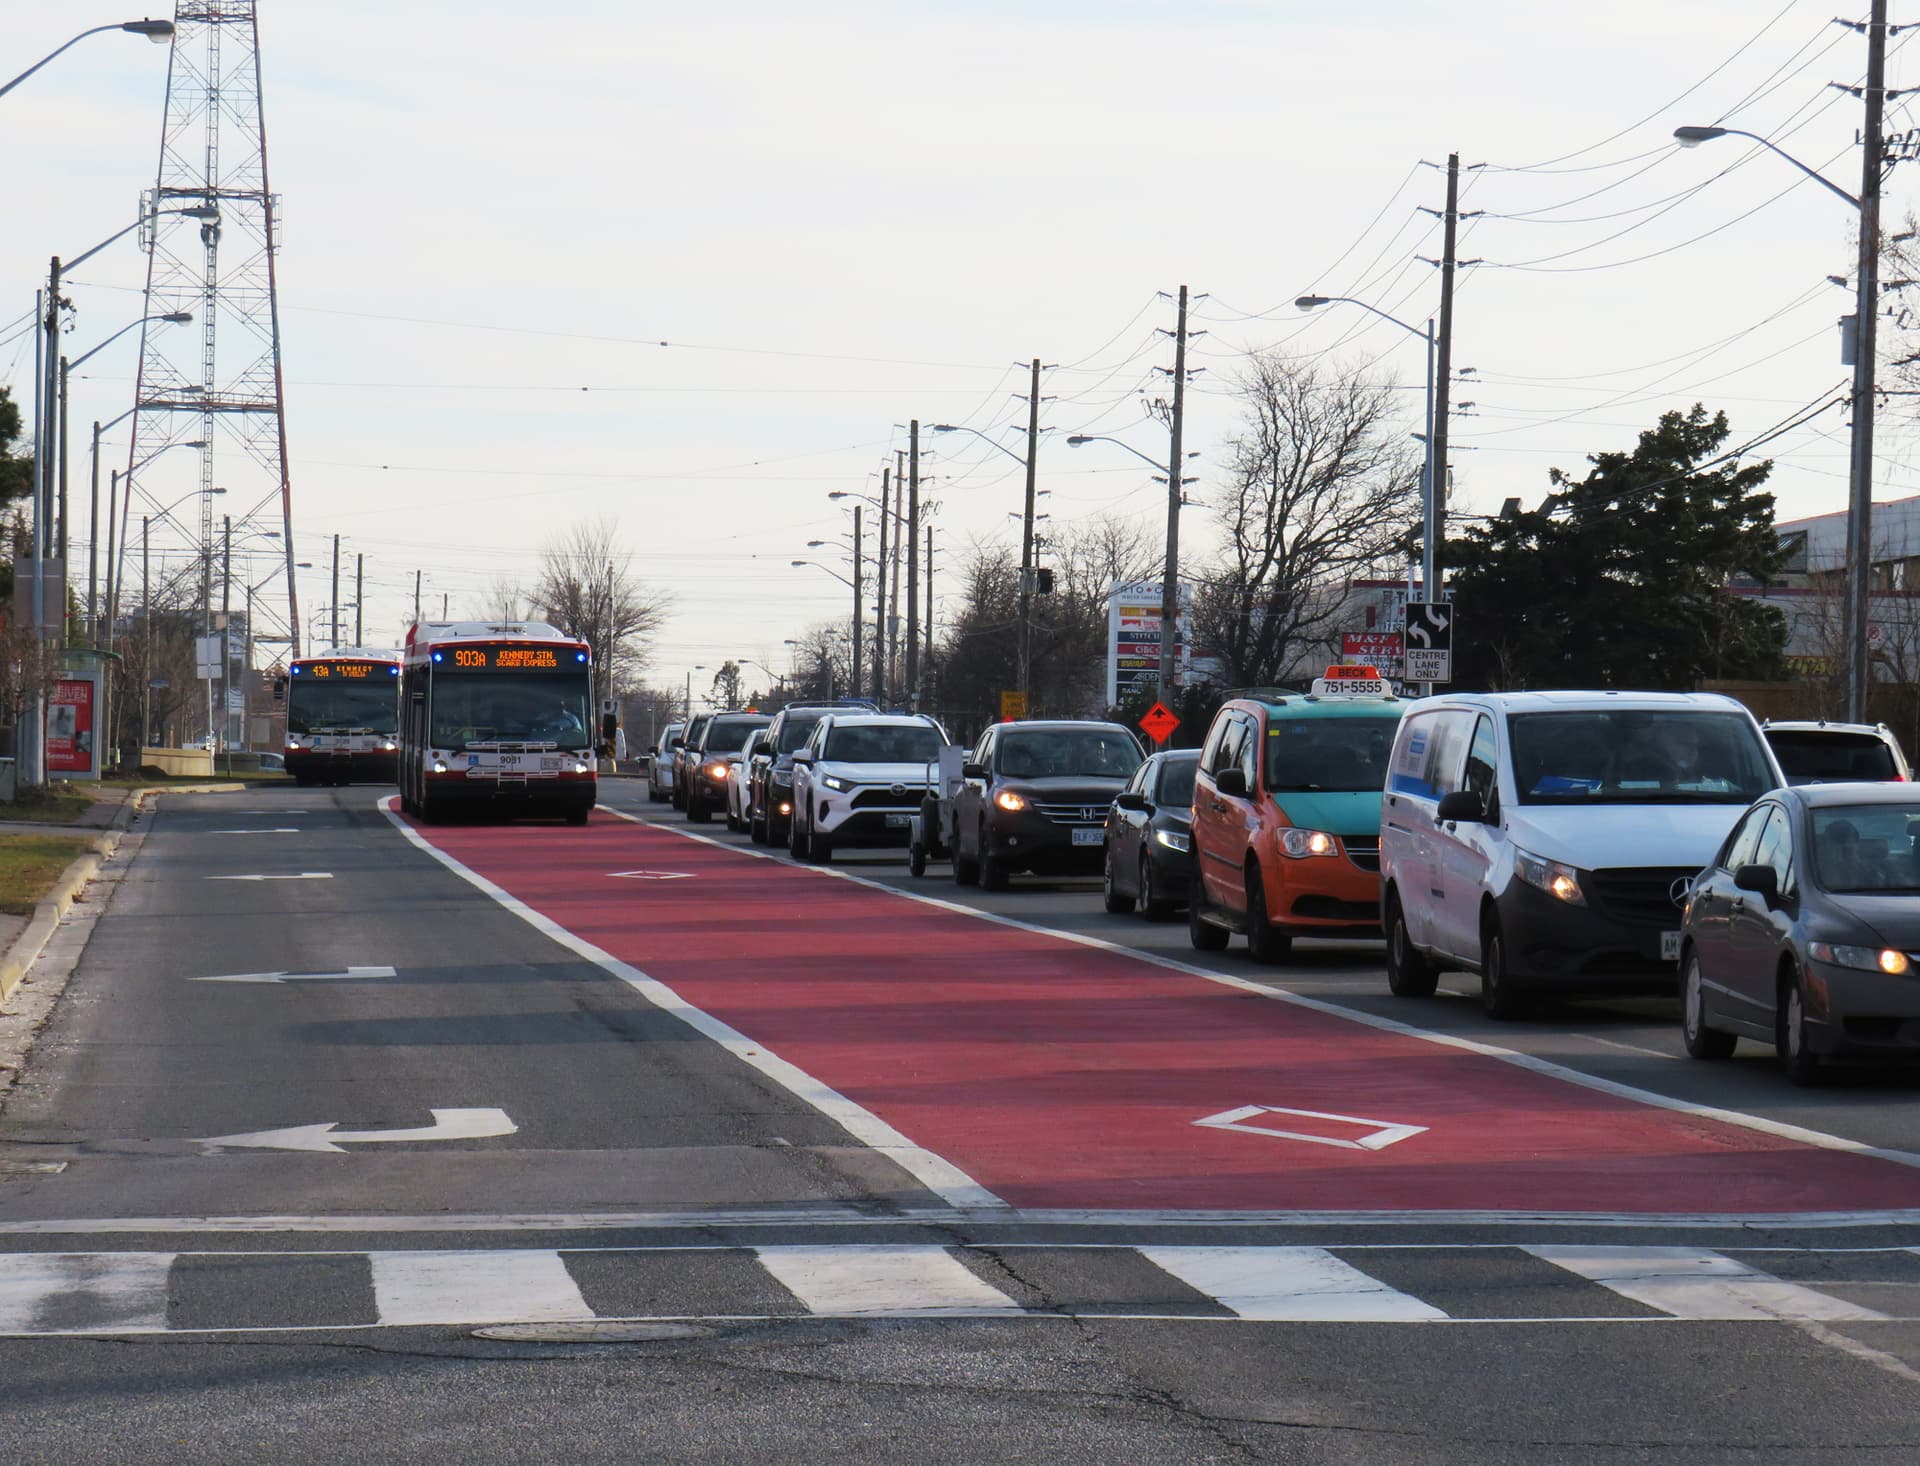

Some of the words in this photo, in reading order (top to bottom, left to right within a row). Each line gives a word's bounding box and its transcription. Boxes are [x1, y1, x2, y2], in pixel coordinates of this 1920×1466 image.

[455, 650, 486, 666] 903A
[499, 650, 534, 660] KENNEDY
[537, 650, 553, 660] STN
[1408, 651, 1447, 660] CENTRE
[496, 659, 521, 667] SCARB
[523, 659, 557, 667] EXPRESS
[1415, 661, 1440, 670] LANE
[313, 665, 329, 677] 43A
[1338, 668, 1367, 678] BECK
[1415, 670, 1440, 679] ONLY
[1324, 681, 1383, 694] 751-5555
